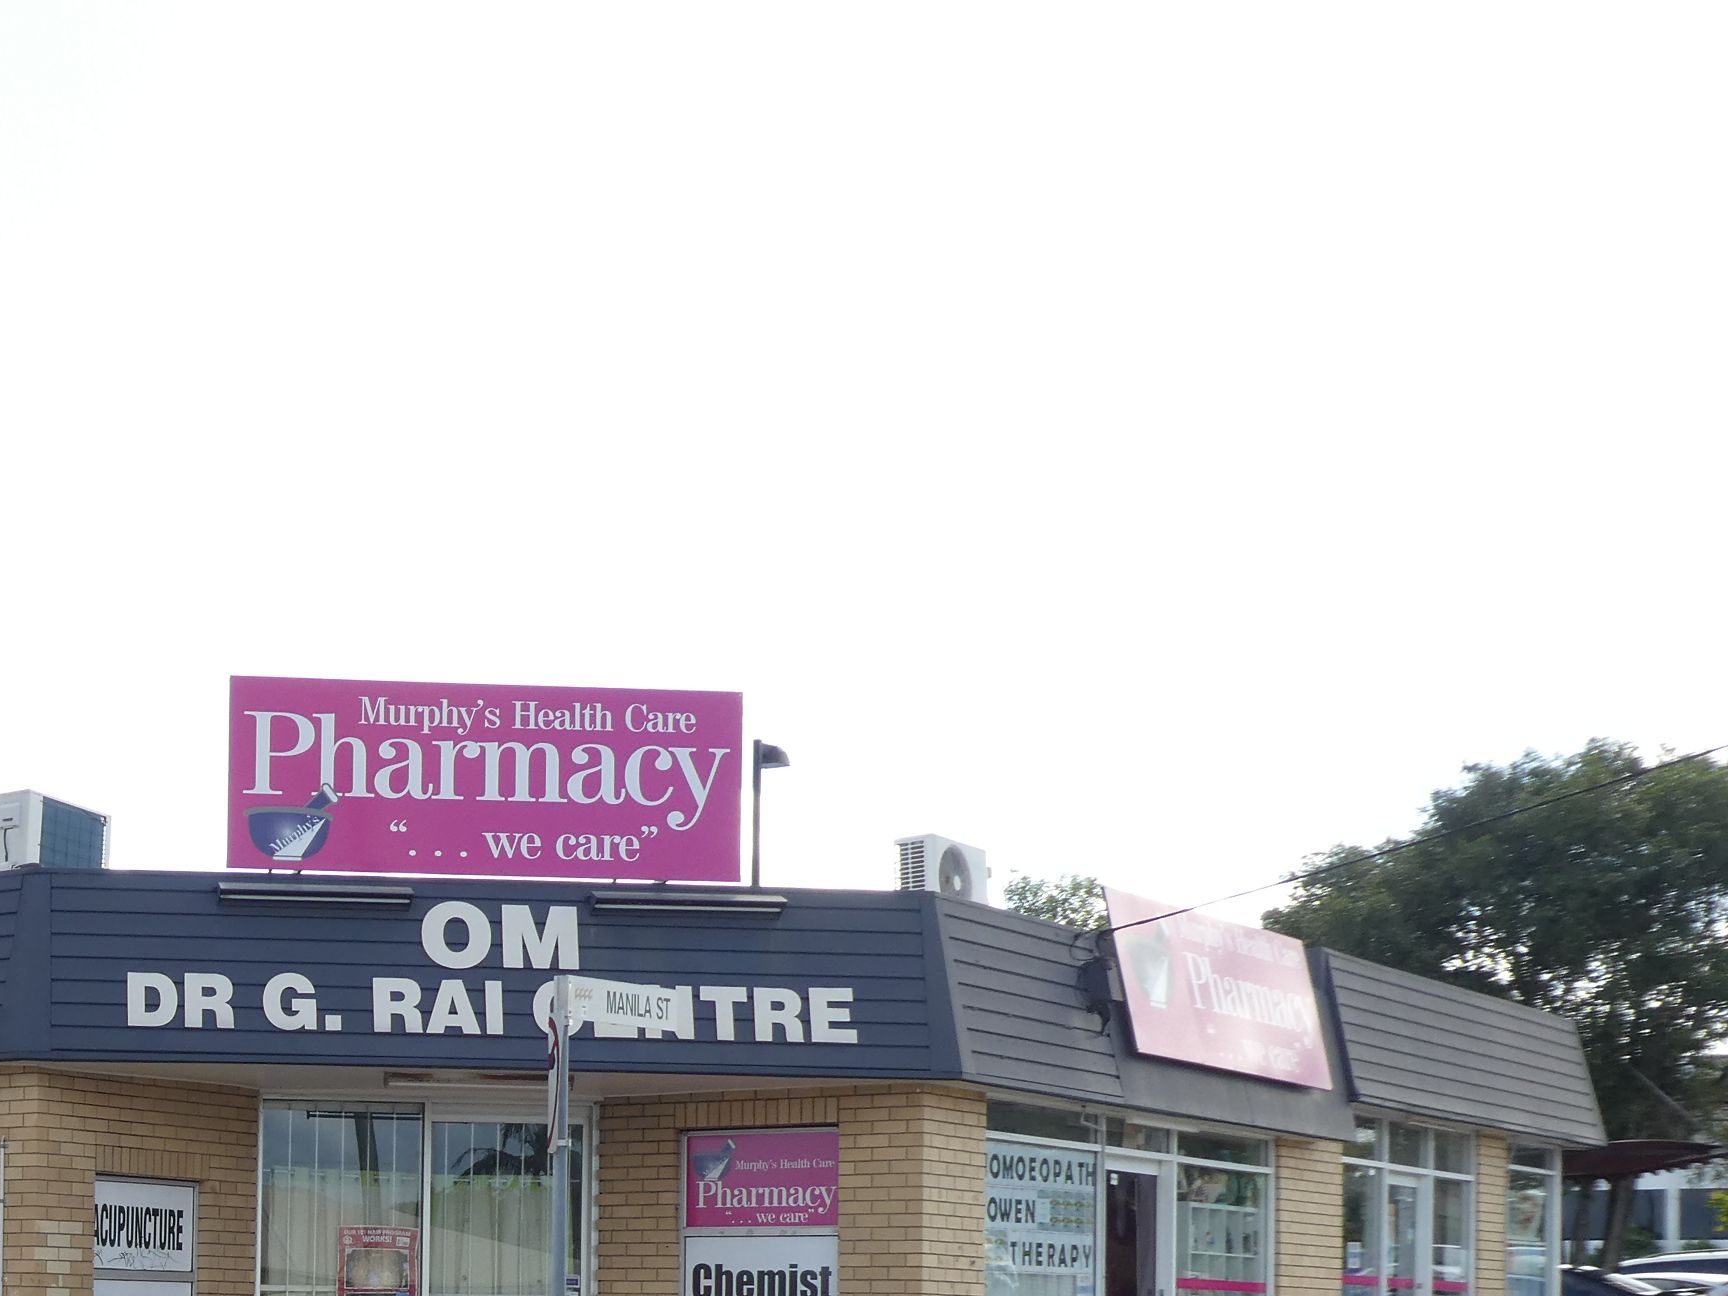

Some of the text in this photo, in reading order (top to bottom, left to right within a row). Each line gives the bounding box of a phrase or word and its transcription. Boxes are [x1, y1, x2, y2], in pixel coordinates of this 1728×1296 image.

[357, 695, 697, 736] Murphy's Health Care
[242, 710, 730, 831] Pharmacy
[482, 831, 542, 860] we
[421, 900, 581, 970] OM
[124, 971, 859, 1044] DR G. RAI CTRE
[606, 989, 671, 1020] MANILA ST
[1183, 951, 1313, 1047] Pharmacy
[735, 1158, 835, 1173] Murphy's Health Care
[695, 1180, 837, 1214] Pharmacy
[95, 1203, 183, 1251] ACUPUNCTURE
[756, 1212, 775, 1223] we
[1009, 1241, 1092, 1268] THERAPY
